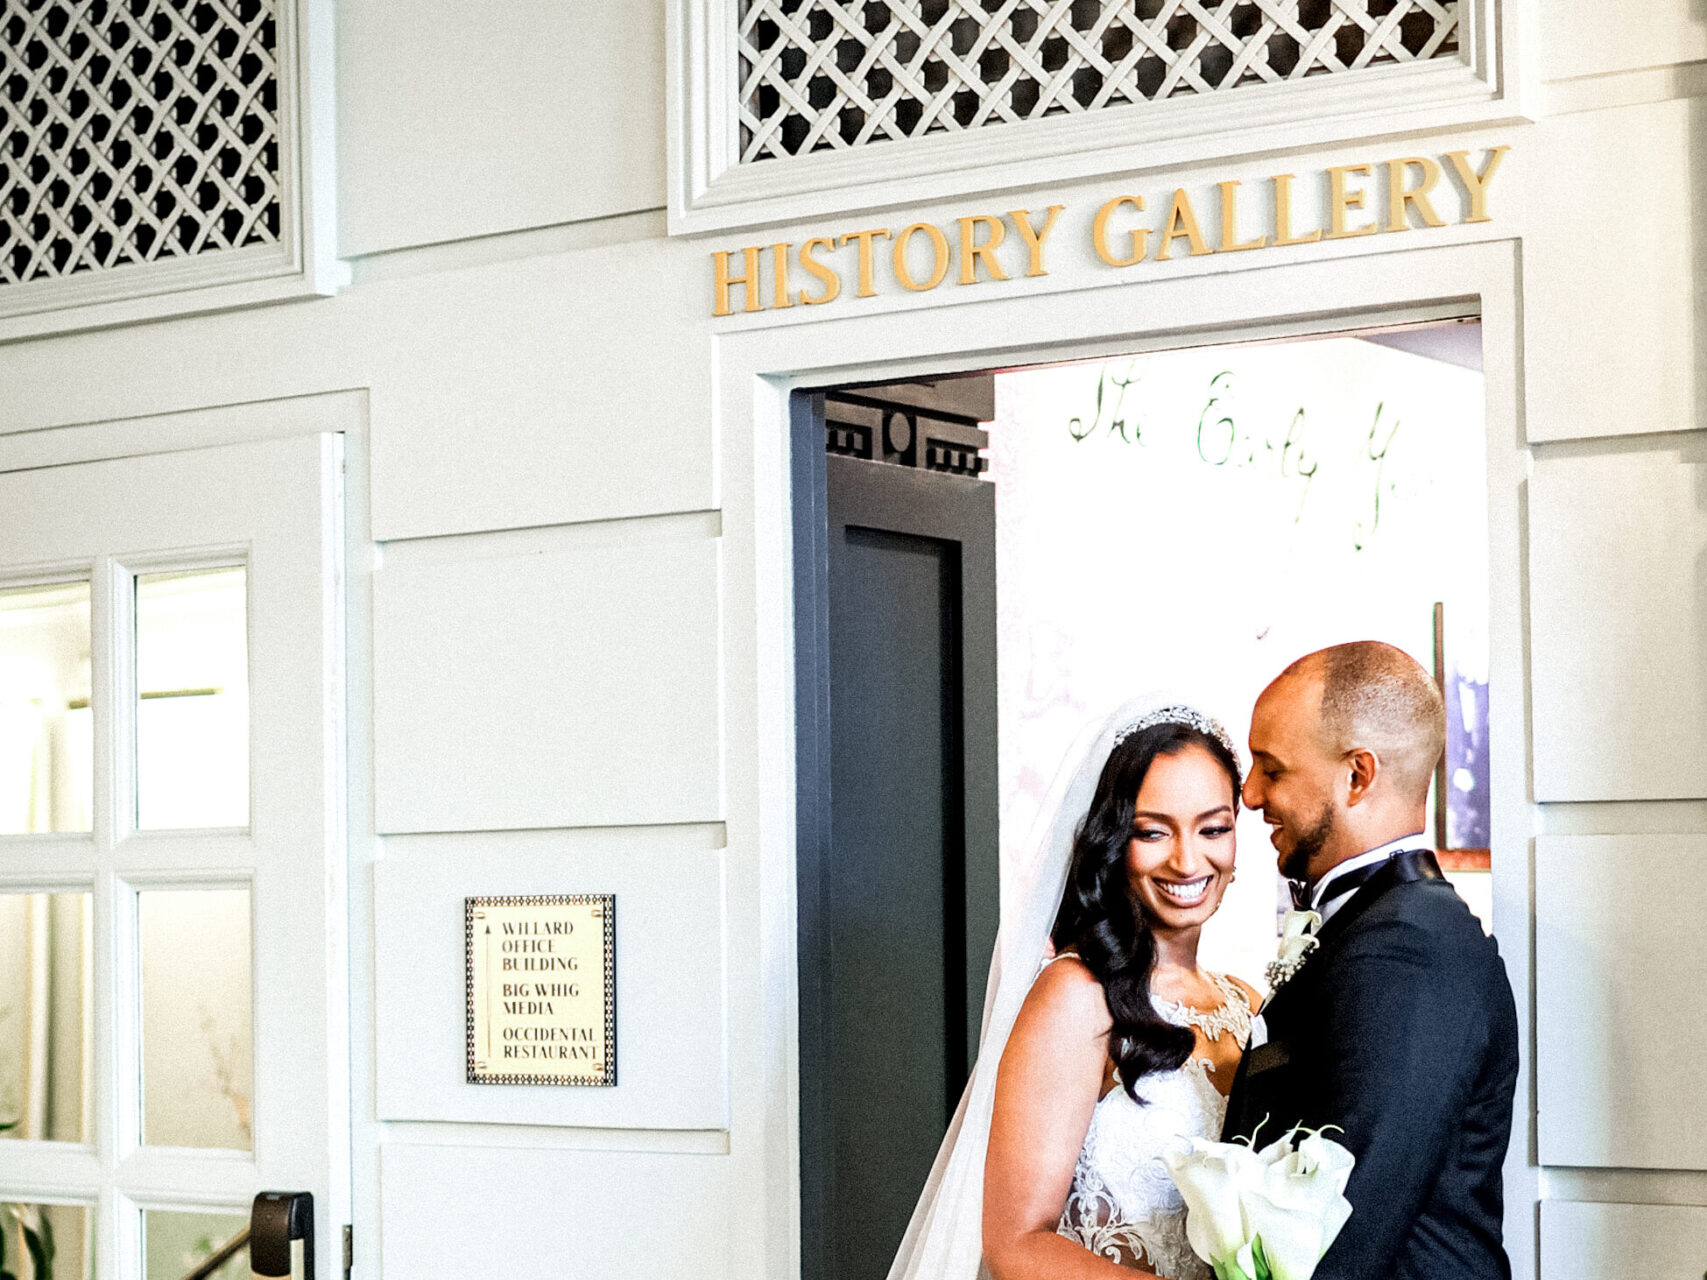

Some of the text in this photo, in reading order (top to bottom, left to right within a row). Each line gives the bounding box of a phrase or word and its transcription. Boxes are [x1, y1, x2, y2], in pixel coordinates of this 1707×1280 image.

[711, 145, 1511, 317] HISTORY GALLERY
[502, 921, 574, 936] WILLARD
[502, 939, 554, 953] OFFICE
[502, 957, 579, 971] BUILDING
[502, 983, 580, 998] BIG WHIG
[503, 1001, 555, 1015] MEDIA
[502, 1027, 597, 1042] OCCIDENTAL
[503, 1044, 599, 1060] RESTAURANT
